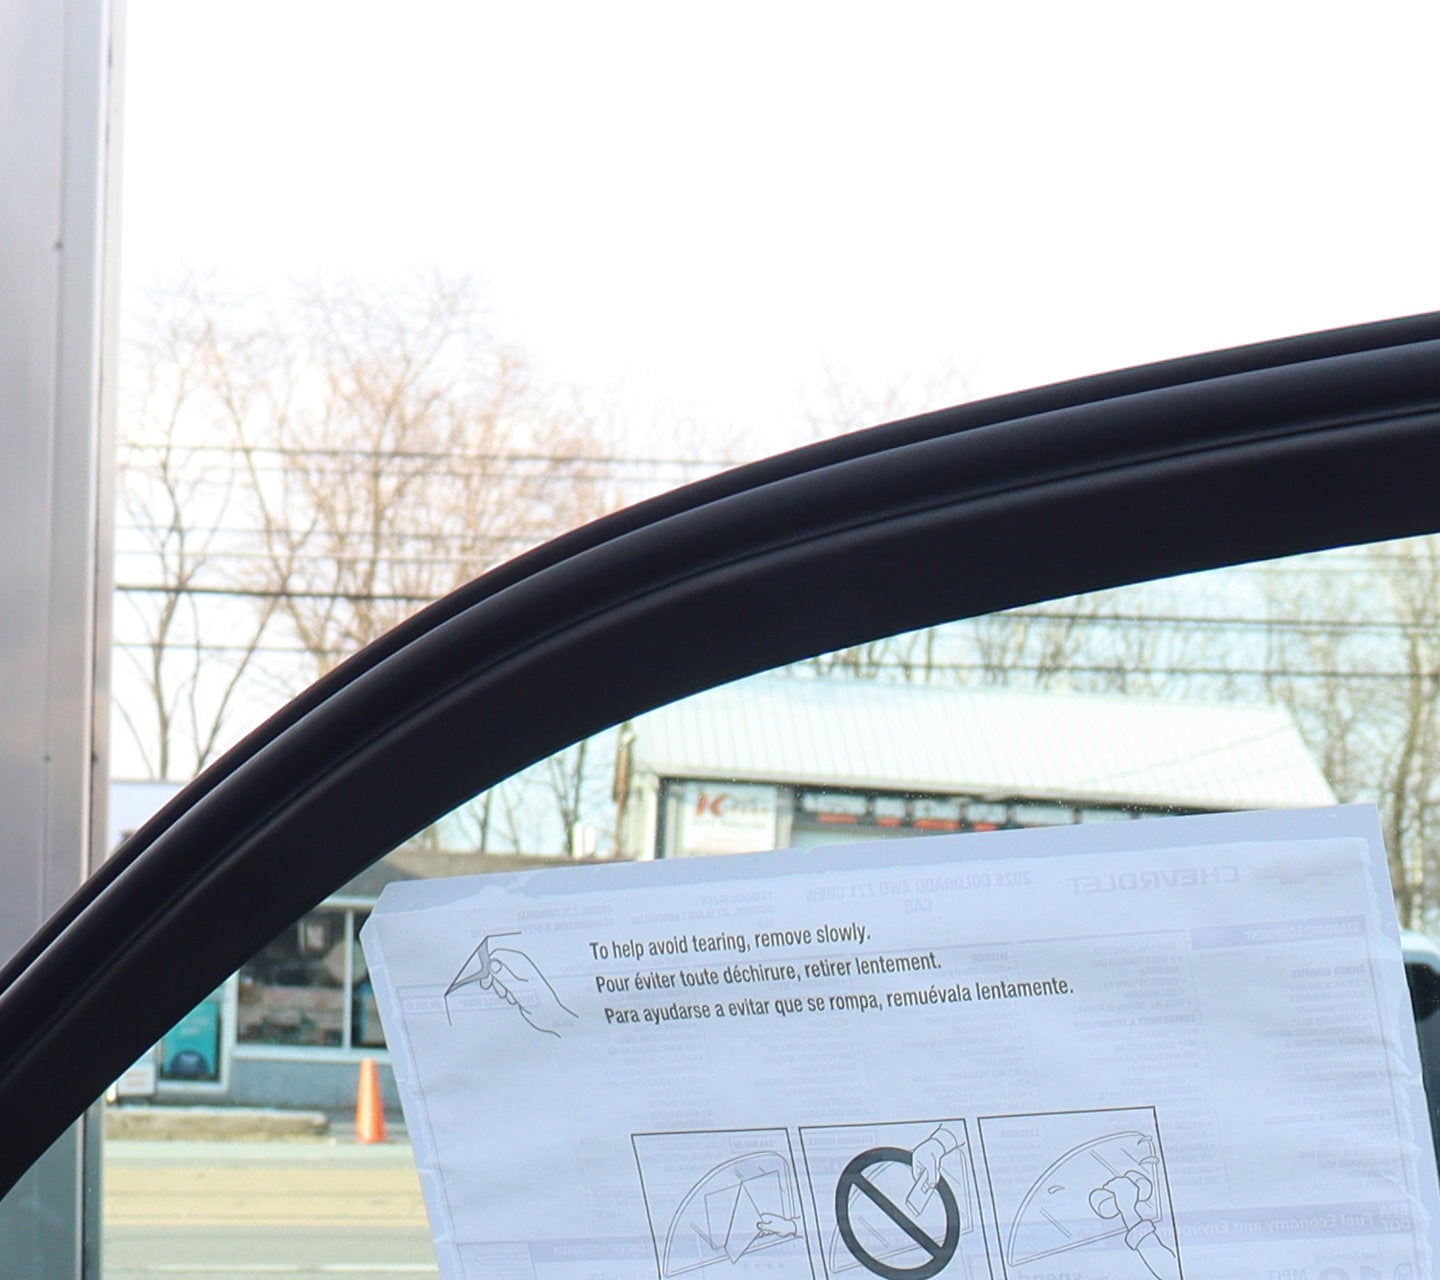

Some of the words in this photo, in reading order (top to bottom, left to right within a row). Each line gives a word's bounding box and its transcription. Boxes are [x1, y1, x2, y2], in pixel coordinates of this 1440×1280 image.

[589, 942, 608, 960] To
[612, 940, 643, 961] help
[649, 936, 688, 956] avoid
[692, 932, 751, 952] tearing,
[755, 930, 811, 948] remove
[817, 922, 871, 945] slowly.
[596, 976, 629, 993] Pour
[635, 971, 676, 991] éviter
[680, 969, 719, 986] toute
[723, 964, 801, 984] déchirure,
[805, 957, 851, 977] retirer
[855, 951, 942, 975] lentement.
[604, 1007, 640, 1024] Para
[644, 1003, 710, 1025] ayudarse
[715, 1005, 725, 1017] a
[729, 998, 769, 1015] evitar
[775, 998, 803, 1017] que
[807, 997, 825, 1011] se
[829, 994, 883, 1013] rompa,
[886, 984, 972, 1007] remuévala
[975, 977, 1074, 1000] lentamente.
